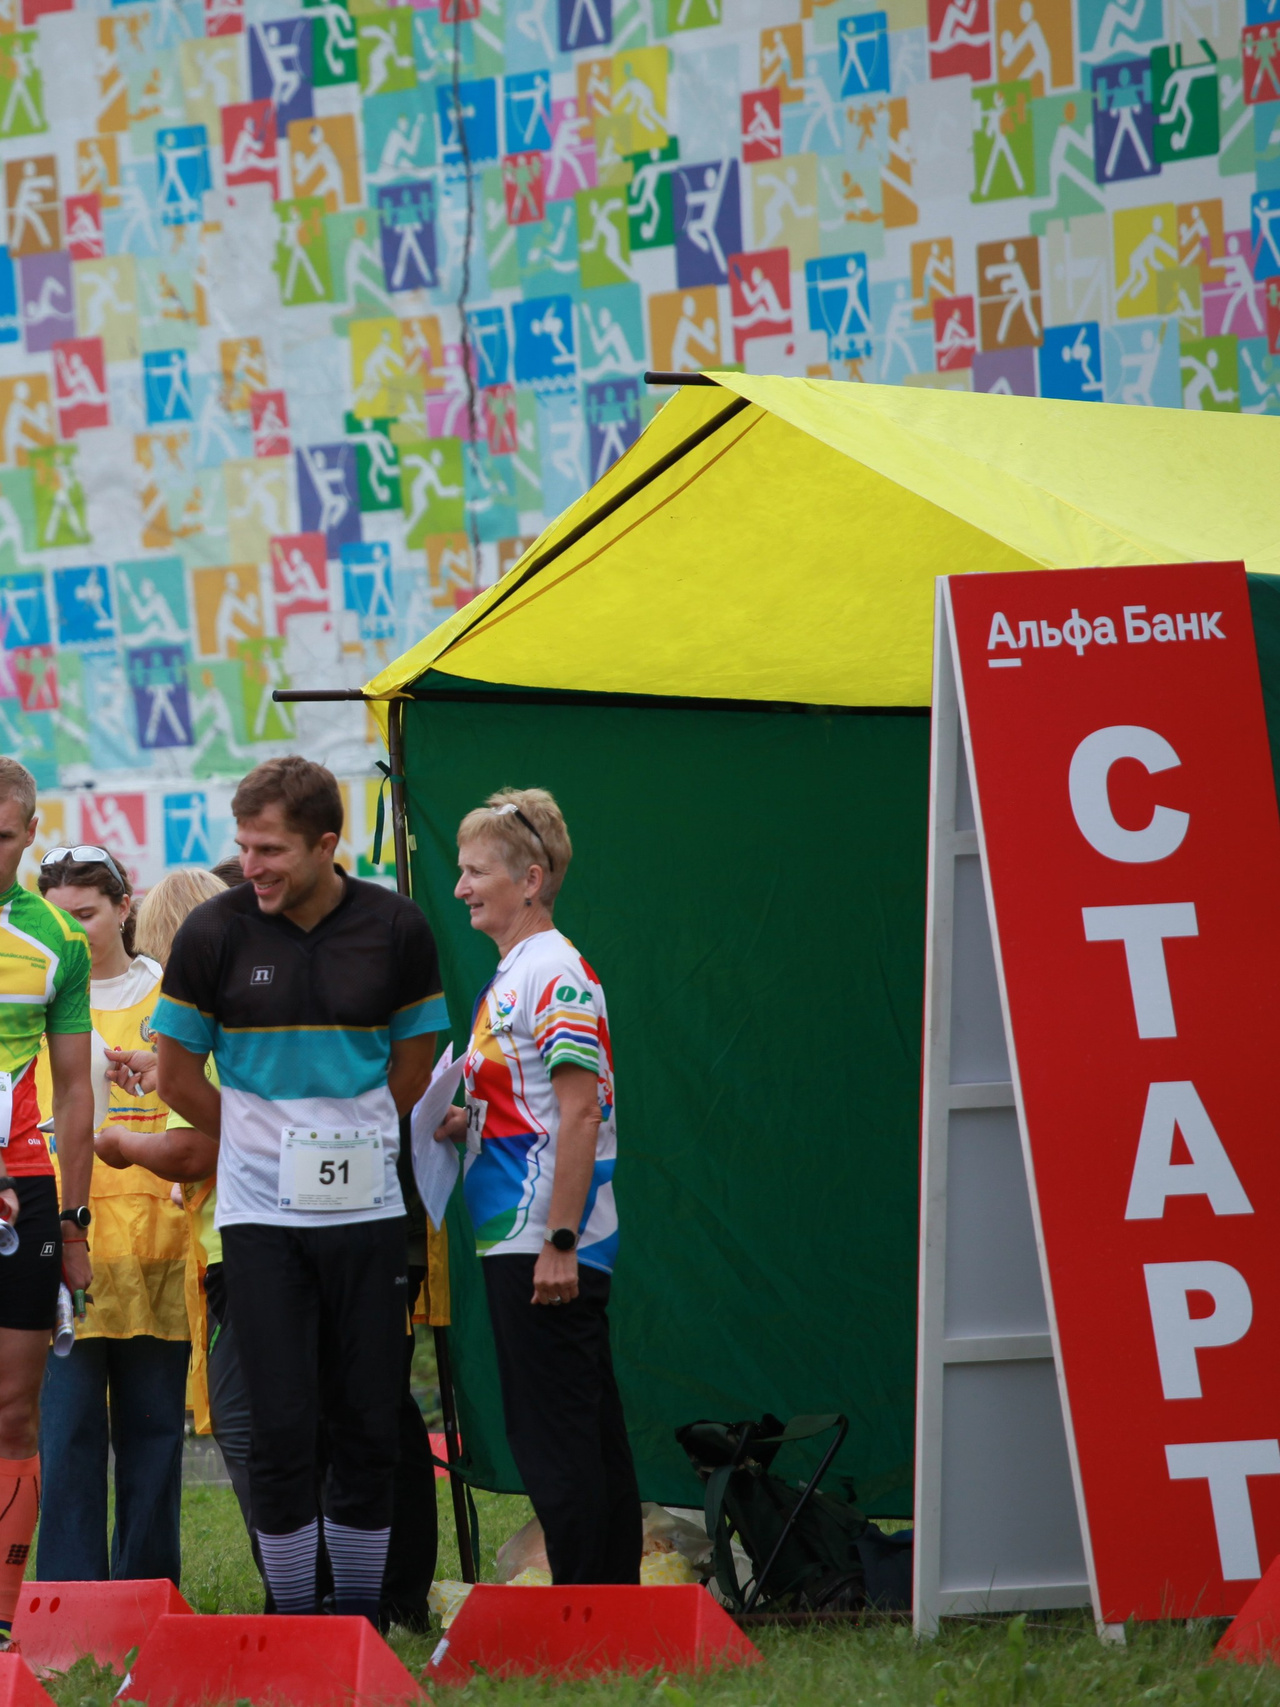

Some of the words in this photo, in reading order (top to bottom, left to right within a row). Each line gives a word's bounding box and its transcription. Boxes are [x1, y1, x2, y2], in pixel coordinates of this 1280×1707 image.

[987, 608, 1118, 656] Альфа
[1123, 605, 1227, 644] Банк
[319, 1159, 349, 1185] 51
[1068, 724, 1280, 1582] СТАРТ
